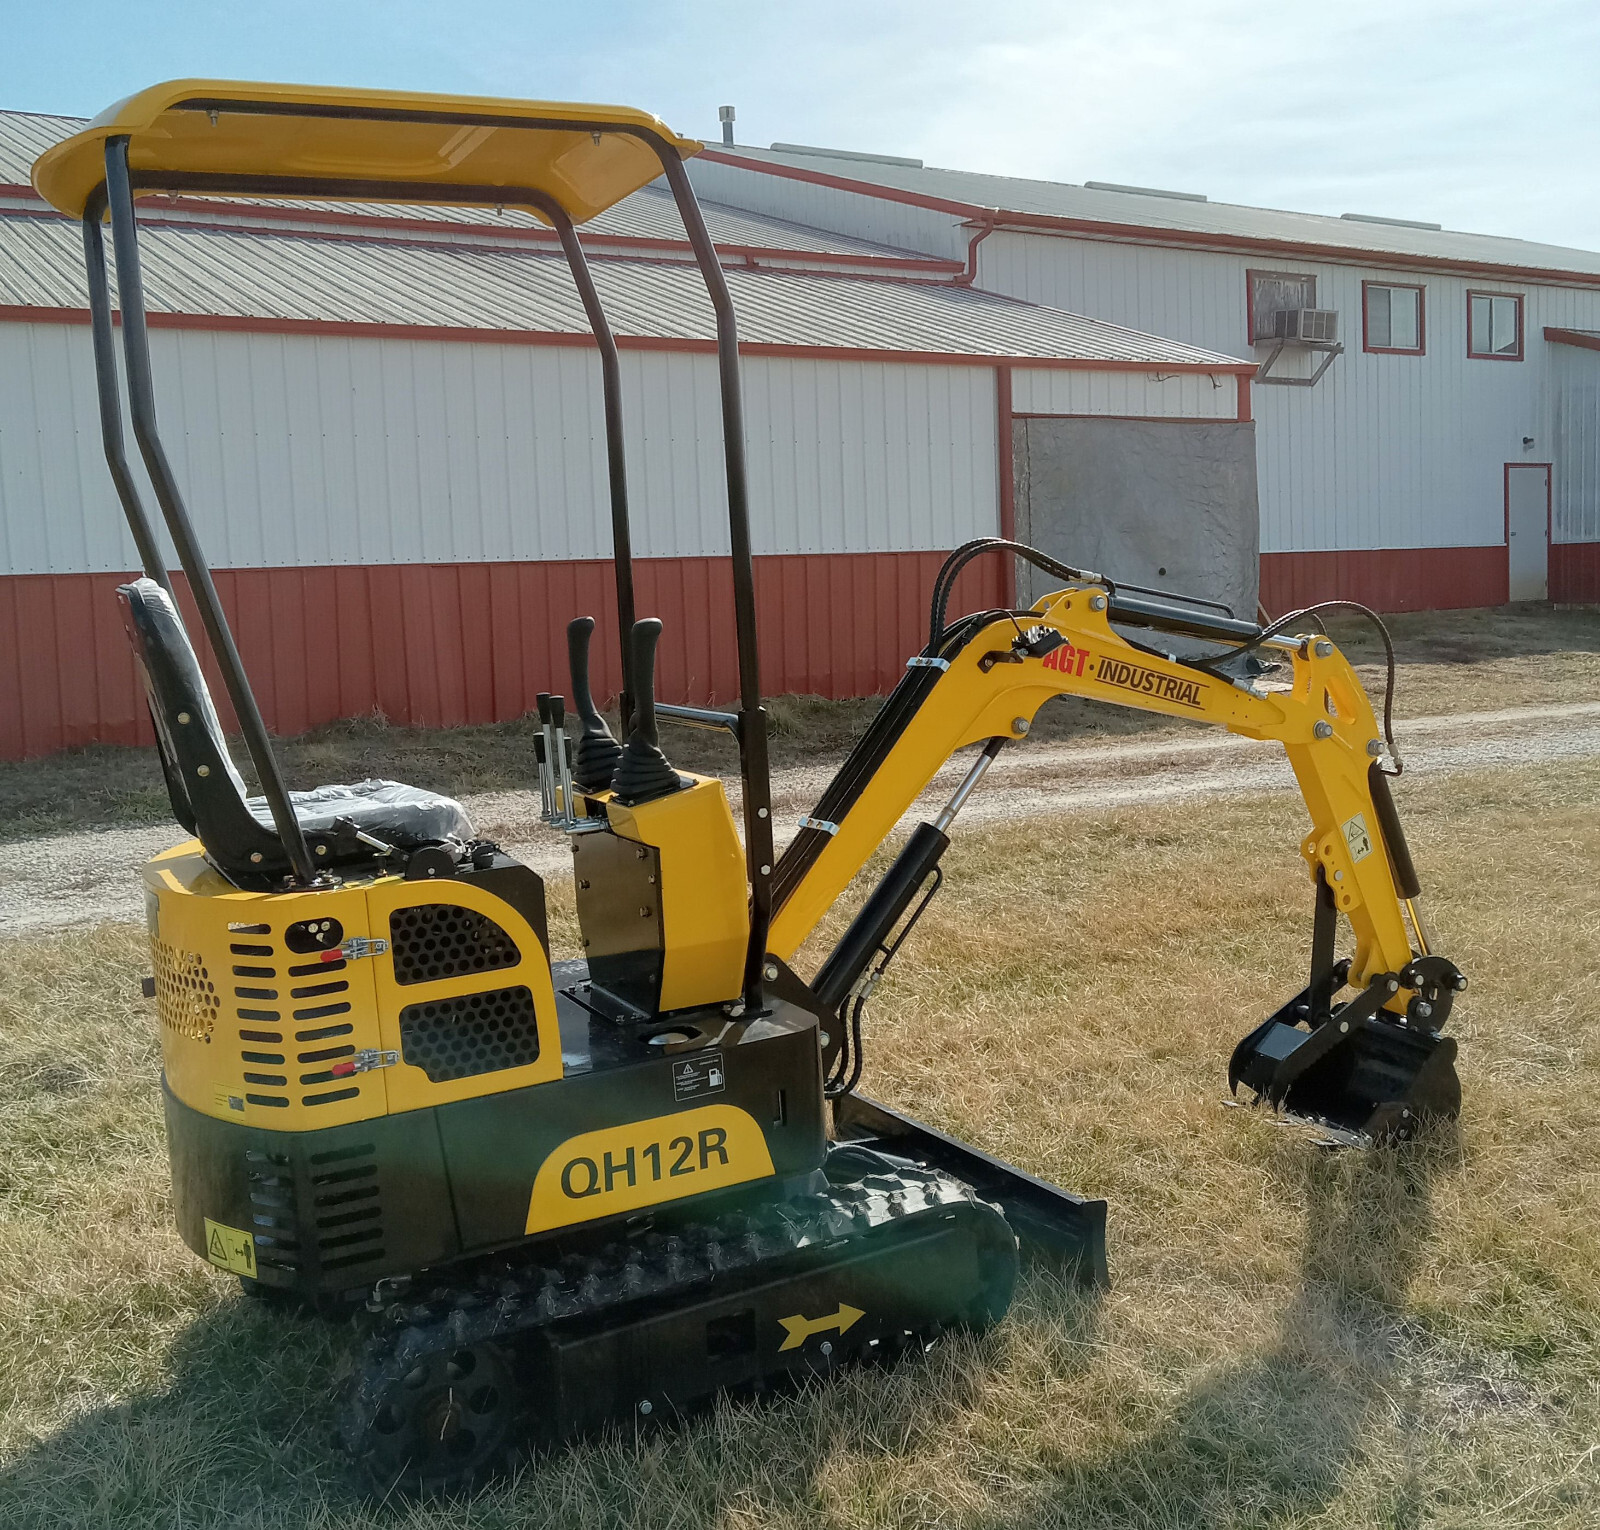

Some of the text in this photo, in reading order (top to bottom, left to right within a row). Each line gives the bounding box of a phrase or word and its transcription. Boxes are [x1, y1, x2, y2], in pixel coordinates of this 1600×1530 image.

[1043, 644, 1201, 705] AGT INDUSTRIAL
[561, 1127, 729, 1198] QH12R
